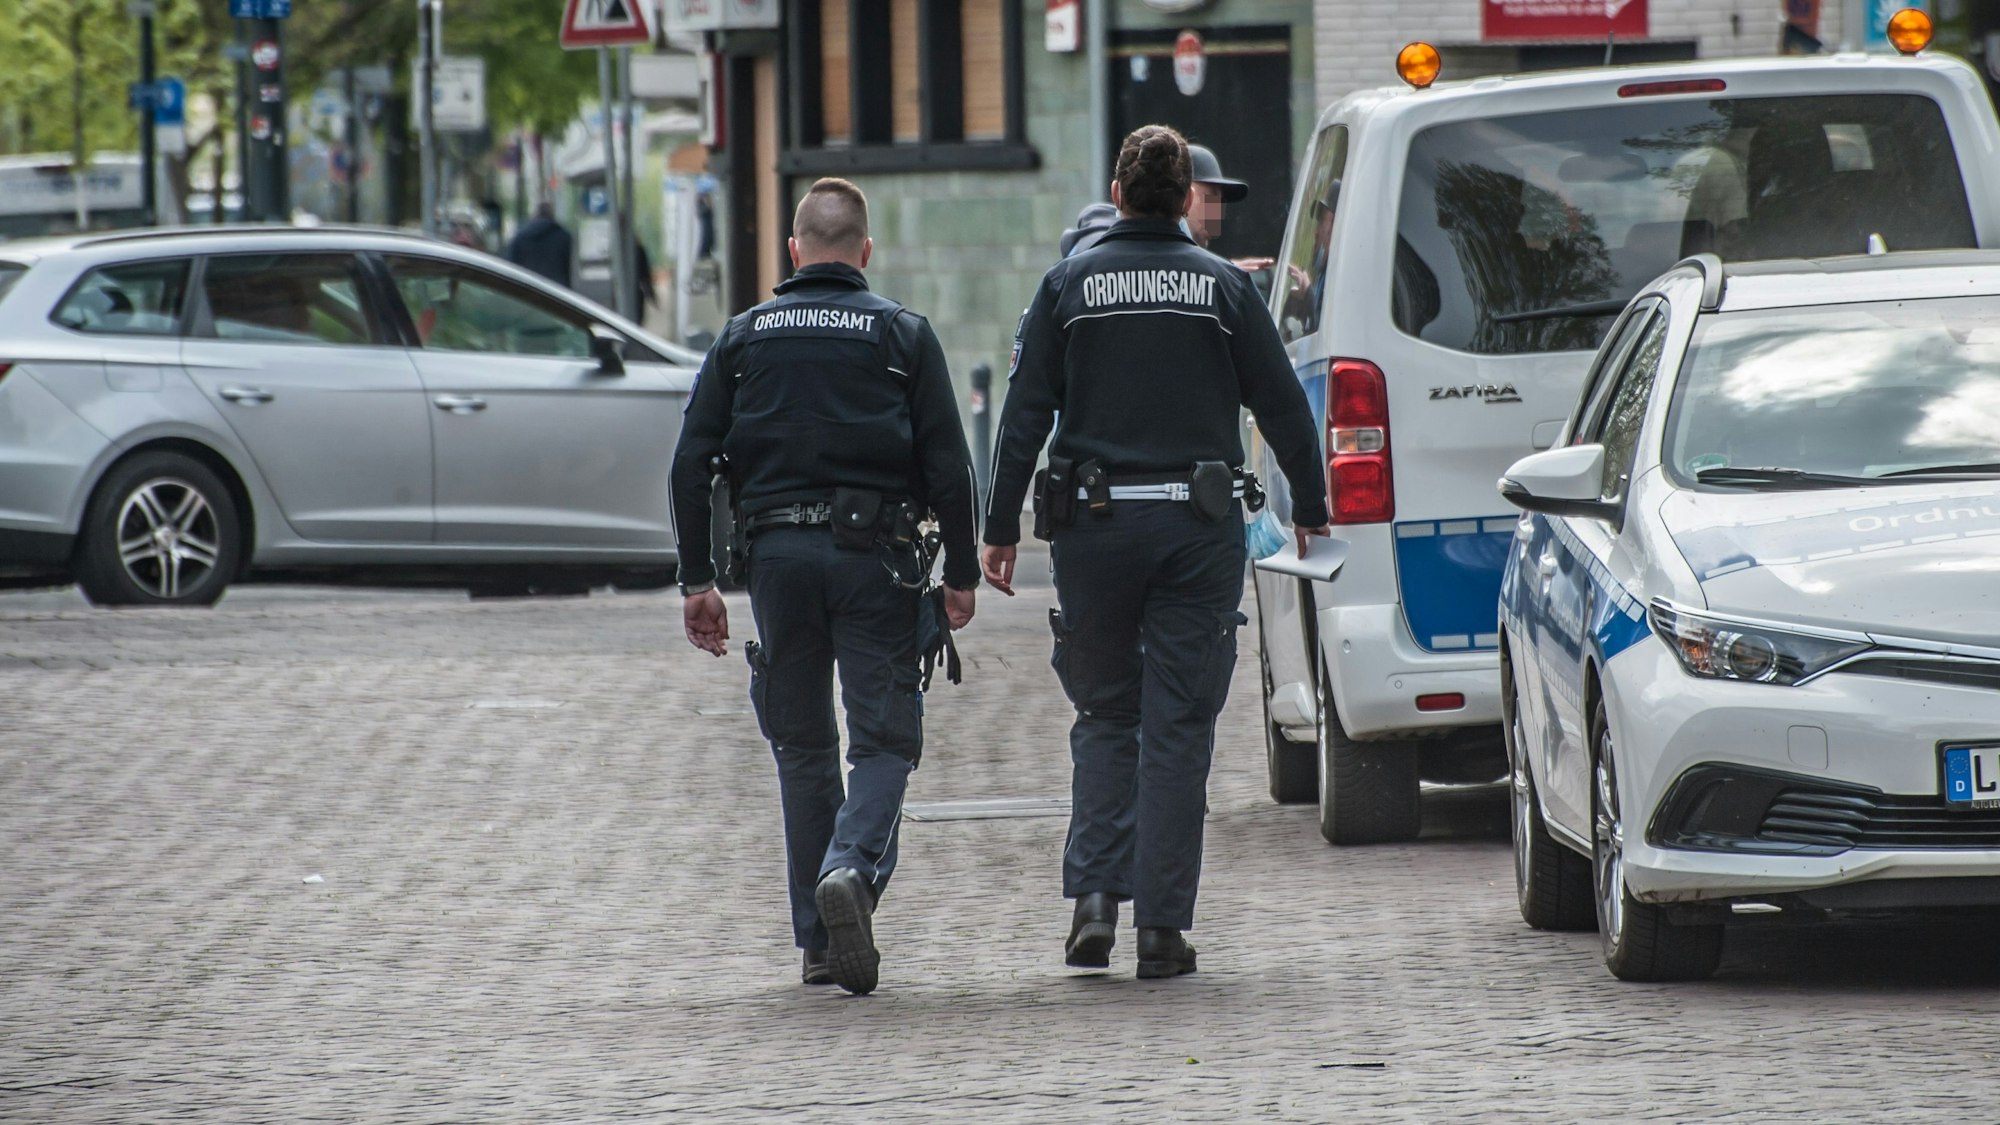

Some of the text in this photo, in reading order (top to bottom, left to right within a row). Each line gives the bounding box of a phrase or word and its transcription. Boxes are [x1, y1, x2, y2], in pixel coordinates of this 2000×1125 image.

[1083, 270, 1216, 308] ORDNUNGSAMT
[754, 309, 875, 332] ORDNUNGSAMT
[1428, 383, 1518, 400] ZAFIRA
[1974, 754, 2000, 793] L
[1955, 780, 1965, 792] D
